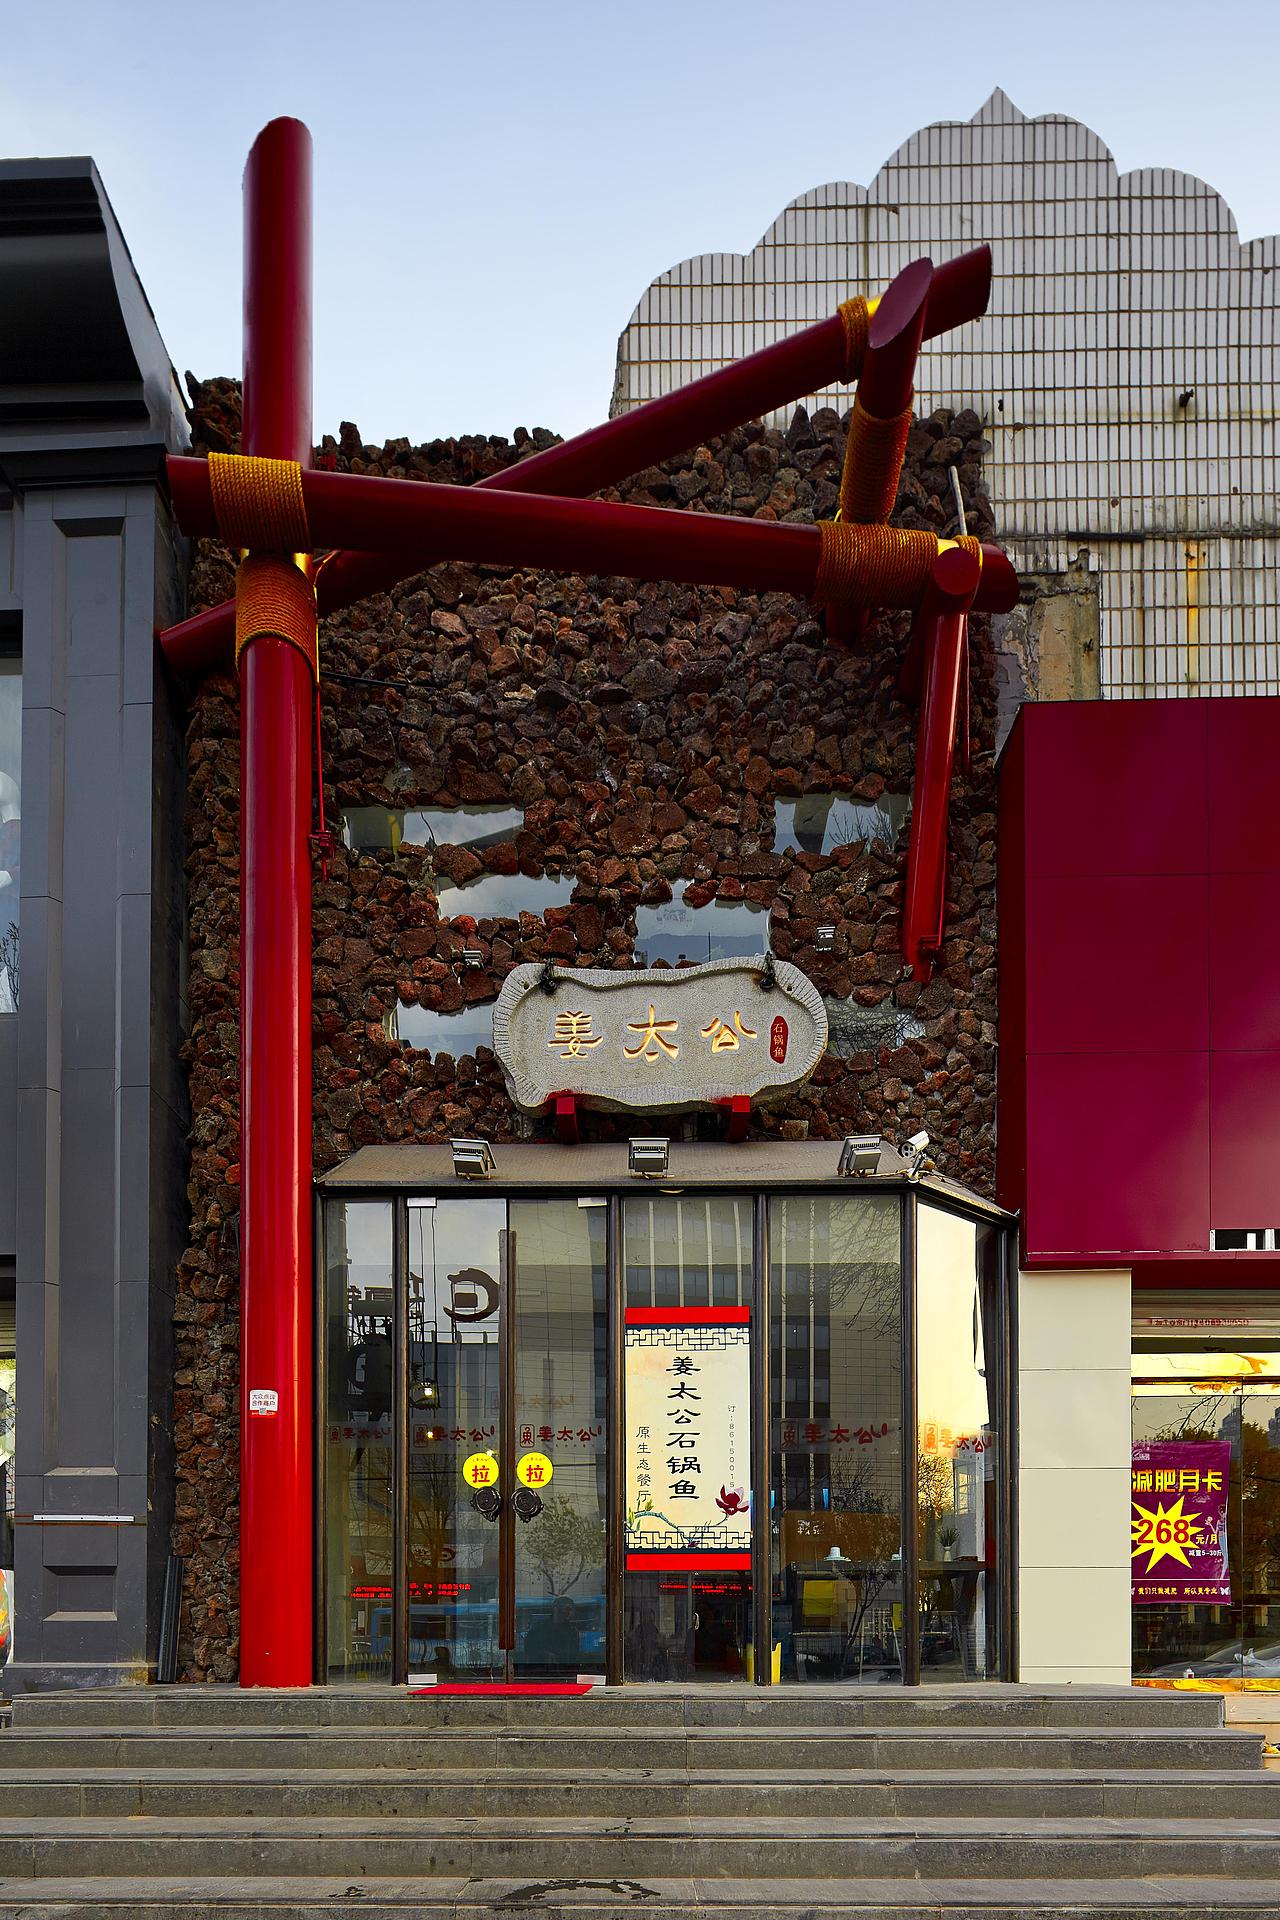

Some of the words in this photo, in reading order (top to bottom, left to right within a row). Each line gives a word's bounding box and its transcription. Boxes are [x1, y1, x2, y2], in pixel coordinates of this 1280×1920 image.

[547, 1004, 757, 1061] 姜太公
[772, 1023, 785, 1058] 石锅鱼
[537, 1425, 598, 1441] 姜太公
[666, 1356, 702, 1500] 姜太公石锅鱼
[802, 1423, 882, 1445] 姜太公
[472, 1465, 490, 1483] 拉
[526, 1465, 544, 1483] 拉
[635, 1426, 652, 1502] 原生态餐厅
[1137, 1519, 1190, 1544] 268
[1195, 1534, 1218, 1545] 元/月
